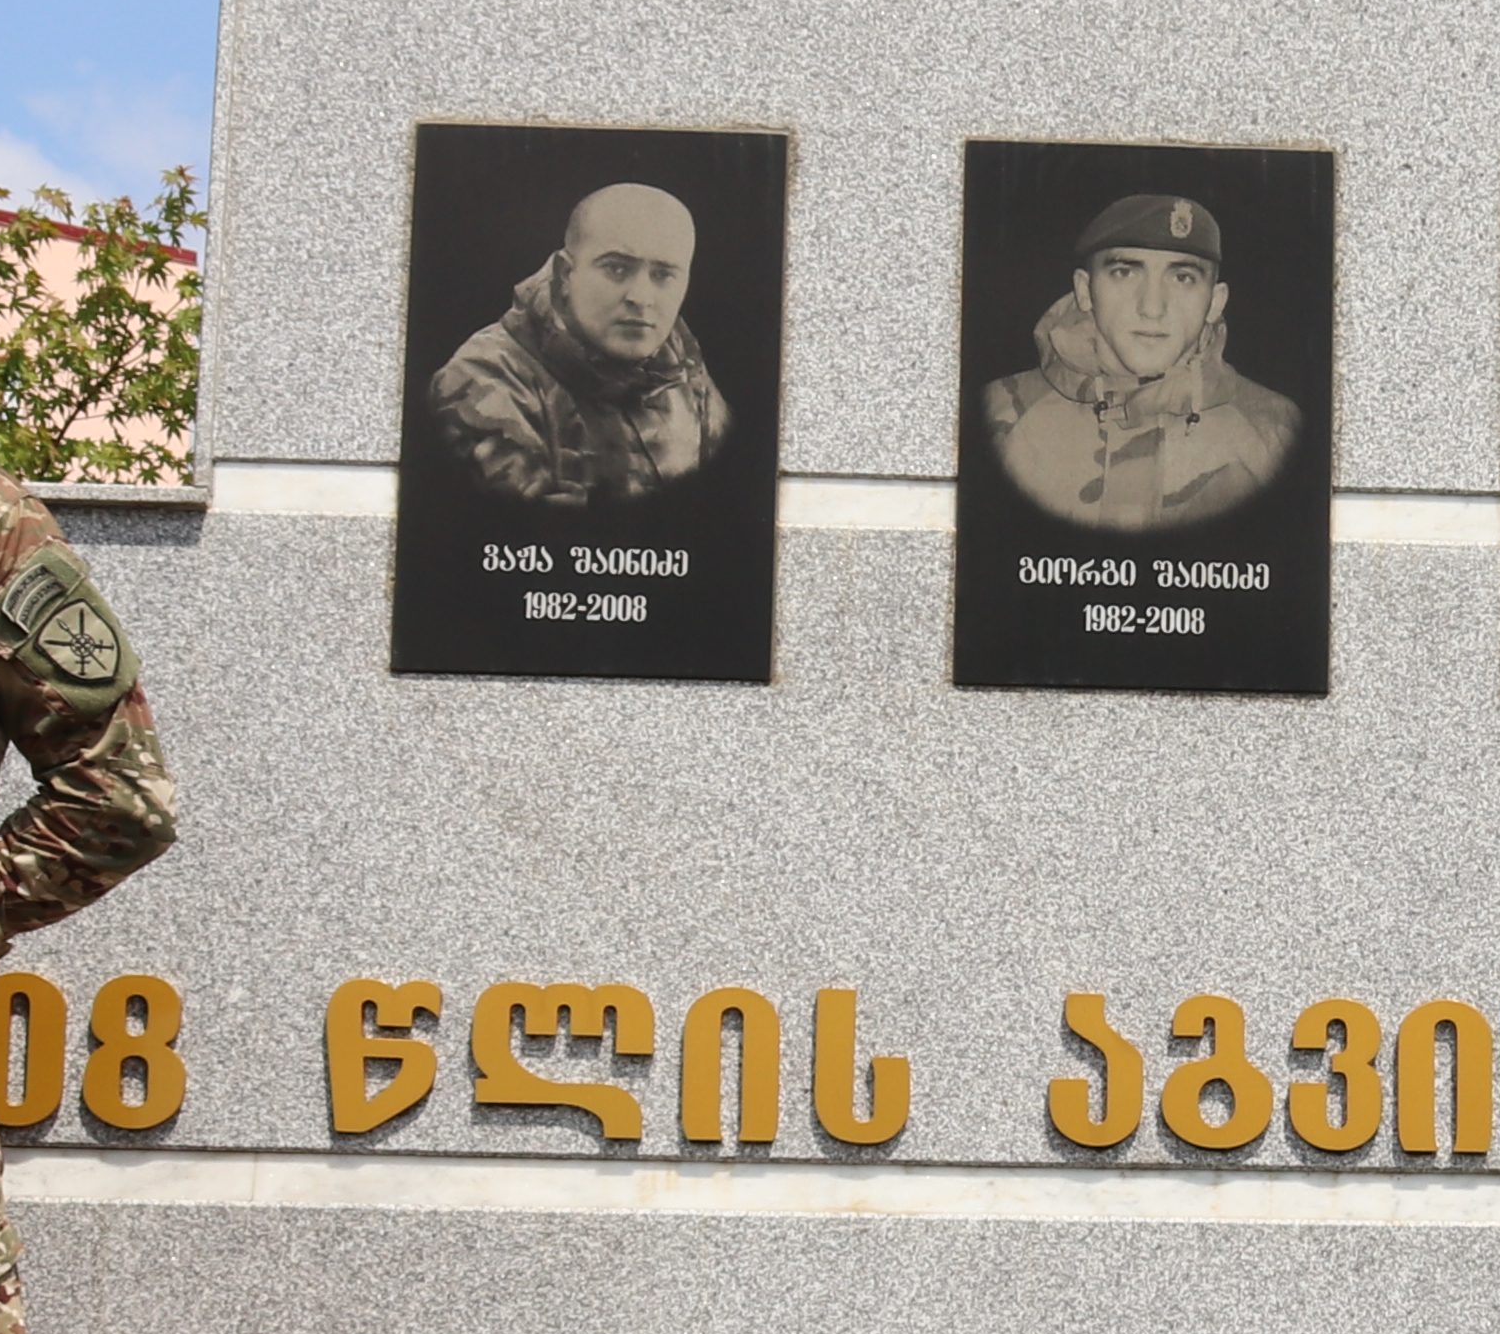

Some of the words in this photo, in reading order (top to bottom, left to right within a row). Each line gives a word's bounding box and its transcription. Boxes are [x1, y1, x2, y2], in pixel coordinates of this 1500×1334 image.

[482, 544, 554, 573] ვაჟა
[569, 546, 689, 577] შაინიძე
[1019, 556, 1137, 587] გიორგი
[1152, 559, 1270, 591] შაინიძე
[523, 591, 647, 623] 1982-2008
[1083, 604, 1206, 635] 1982-2008
[326, 979, 911, 1145] წლის
